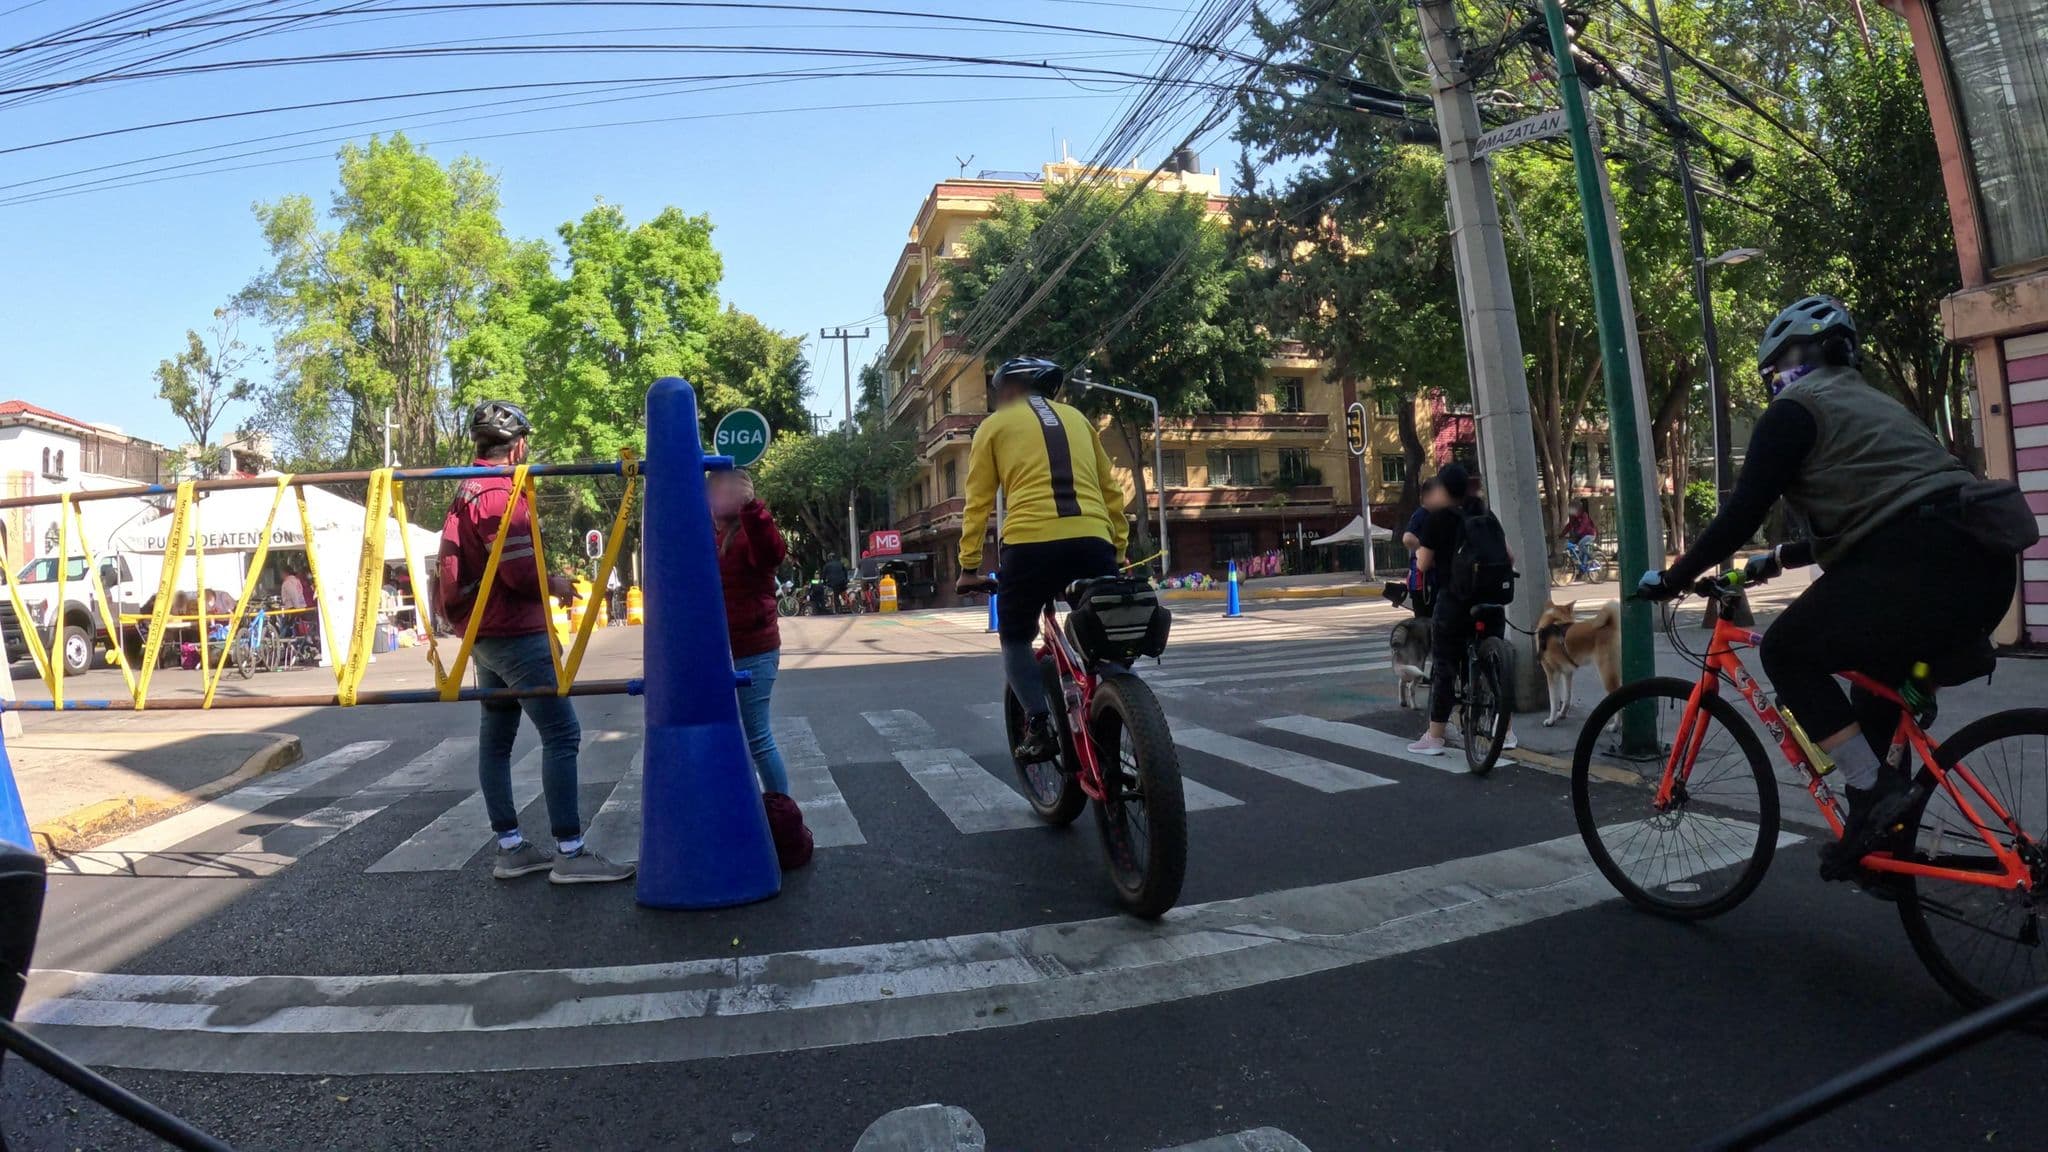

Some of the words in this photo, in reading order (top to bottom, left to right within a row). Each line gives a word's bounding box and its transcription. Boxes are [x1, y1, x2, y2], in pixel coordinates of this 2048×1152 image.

[717, 429, 763, 445] SIGA
[174, 499, 187, 536] MUEVETE
[147, 535, 195, 549] PUO
[171, 537, 180, 548] EN
[876, 534, 900, 549] MB
[167, 550, 176, 566] BICI
[363, 568, 372, 606] MUEVETE
